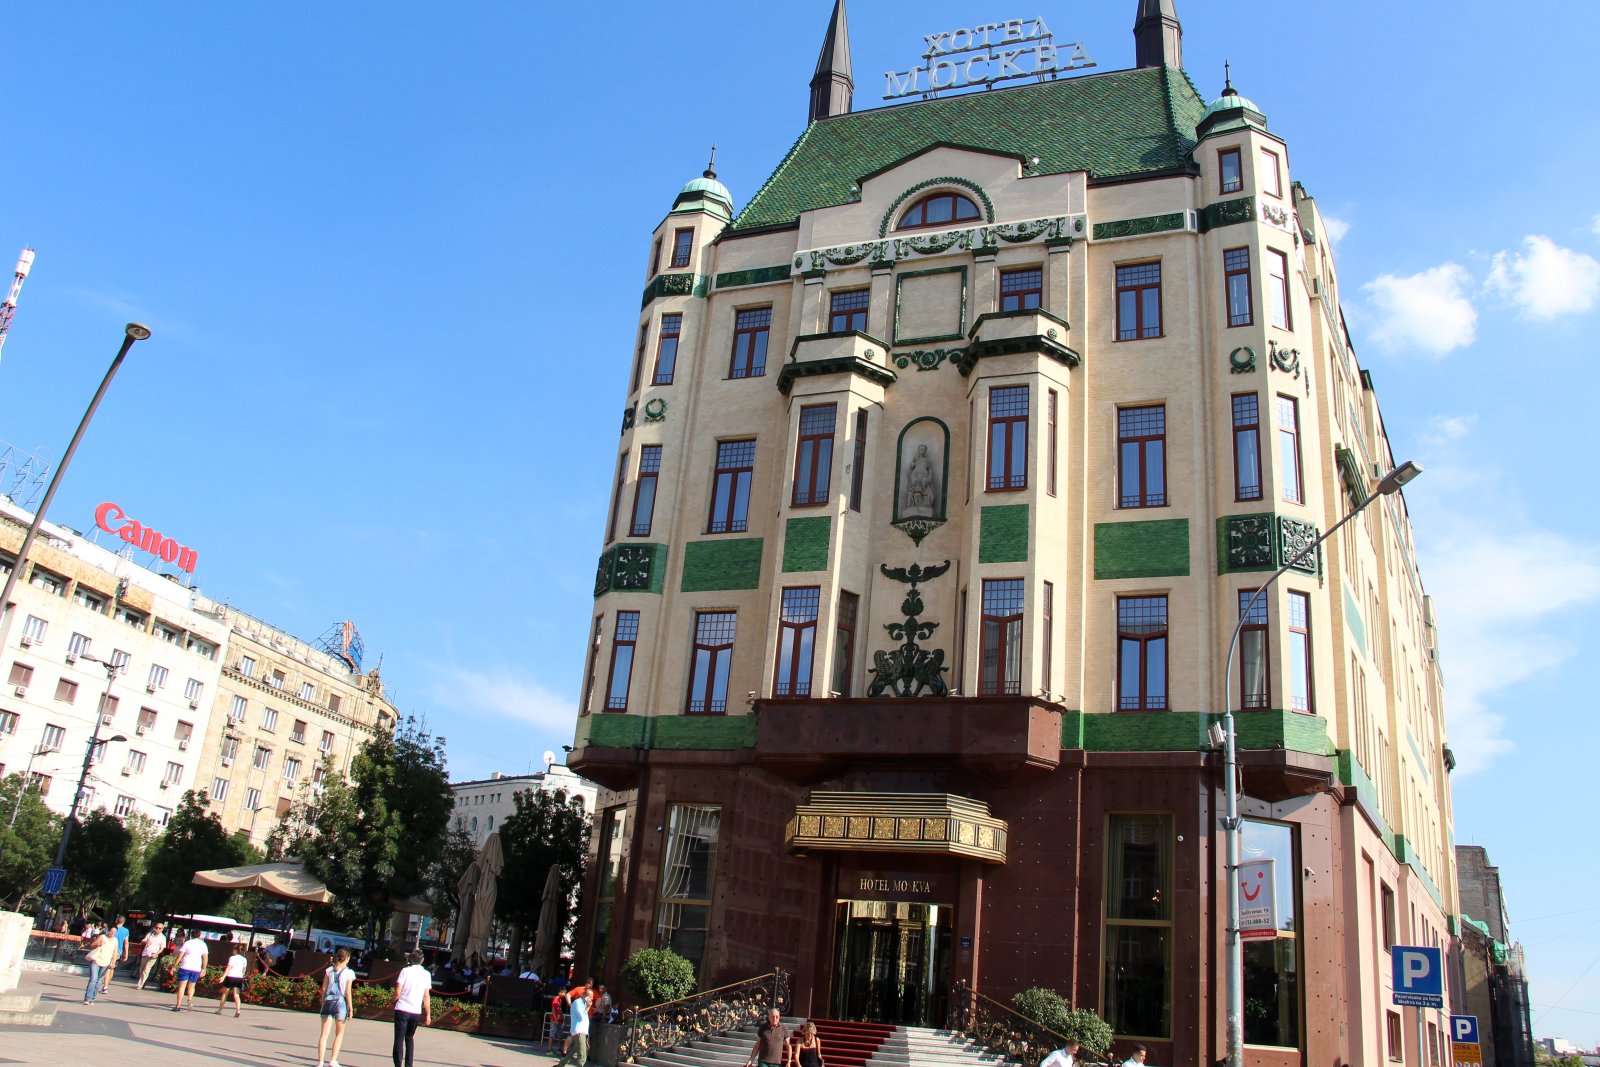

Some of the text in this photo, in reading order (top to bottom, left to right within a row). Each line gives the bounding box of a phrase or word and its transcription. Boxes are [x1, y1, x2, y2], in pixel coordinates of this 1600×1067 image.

[923, 15, 1052, 55] ХОТЕЛ
[884, 41, 1097, 97] МОСКВА
[95, 502, 198, 573] Canon
[860, 879, 930, 893] HOTEL MOKVA
[1403, 952, 1430, 987] P
[1456, 1019, 1471, 1039] P
